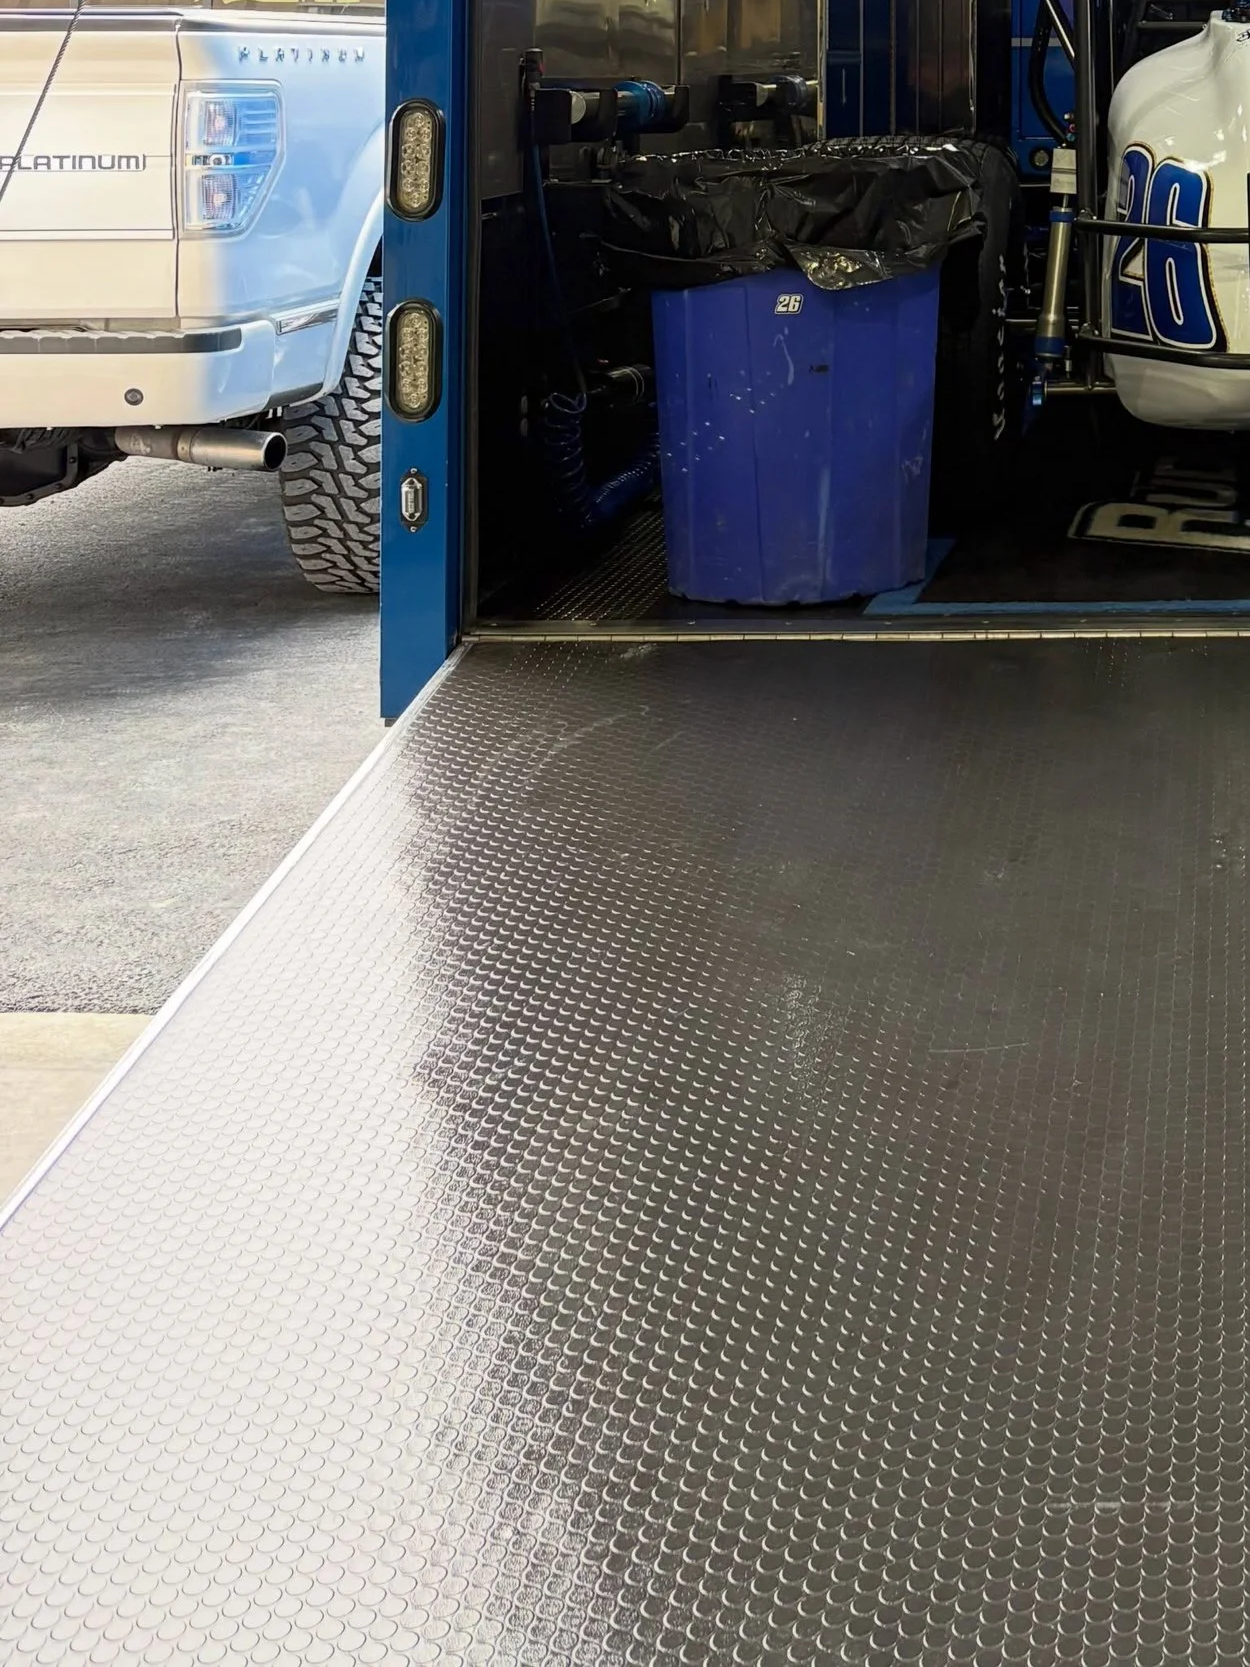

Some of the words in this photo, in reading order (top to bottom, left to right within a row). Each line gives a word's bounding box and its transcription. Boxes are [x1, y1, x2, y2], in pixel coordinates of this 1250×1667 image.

[238, 45, 366, 64] PLATINUM
[0, 154, 140, 170] PLATINUM
[775, 294, 803, 315] 26
